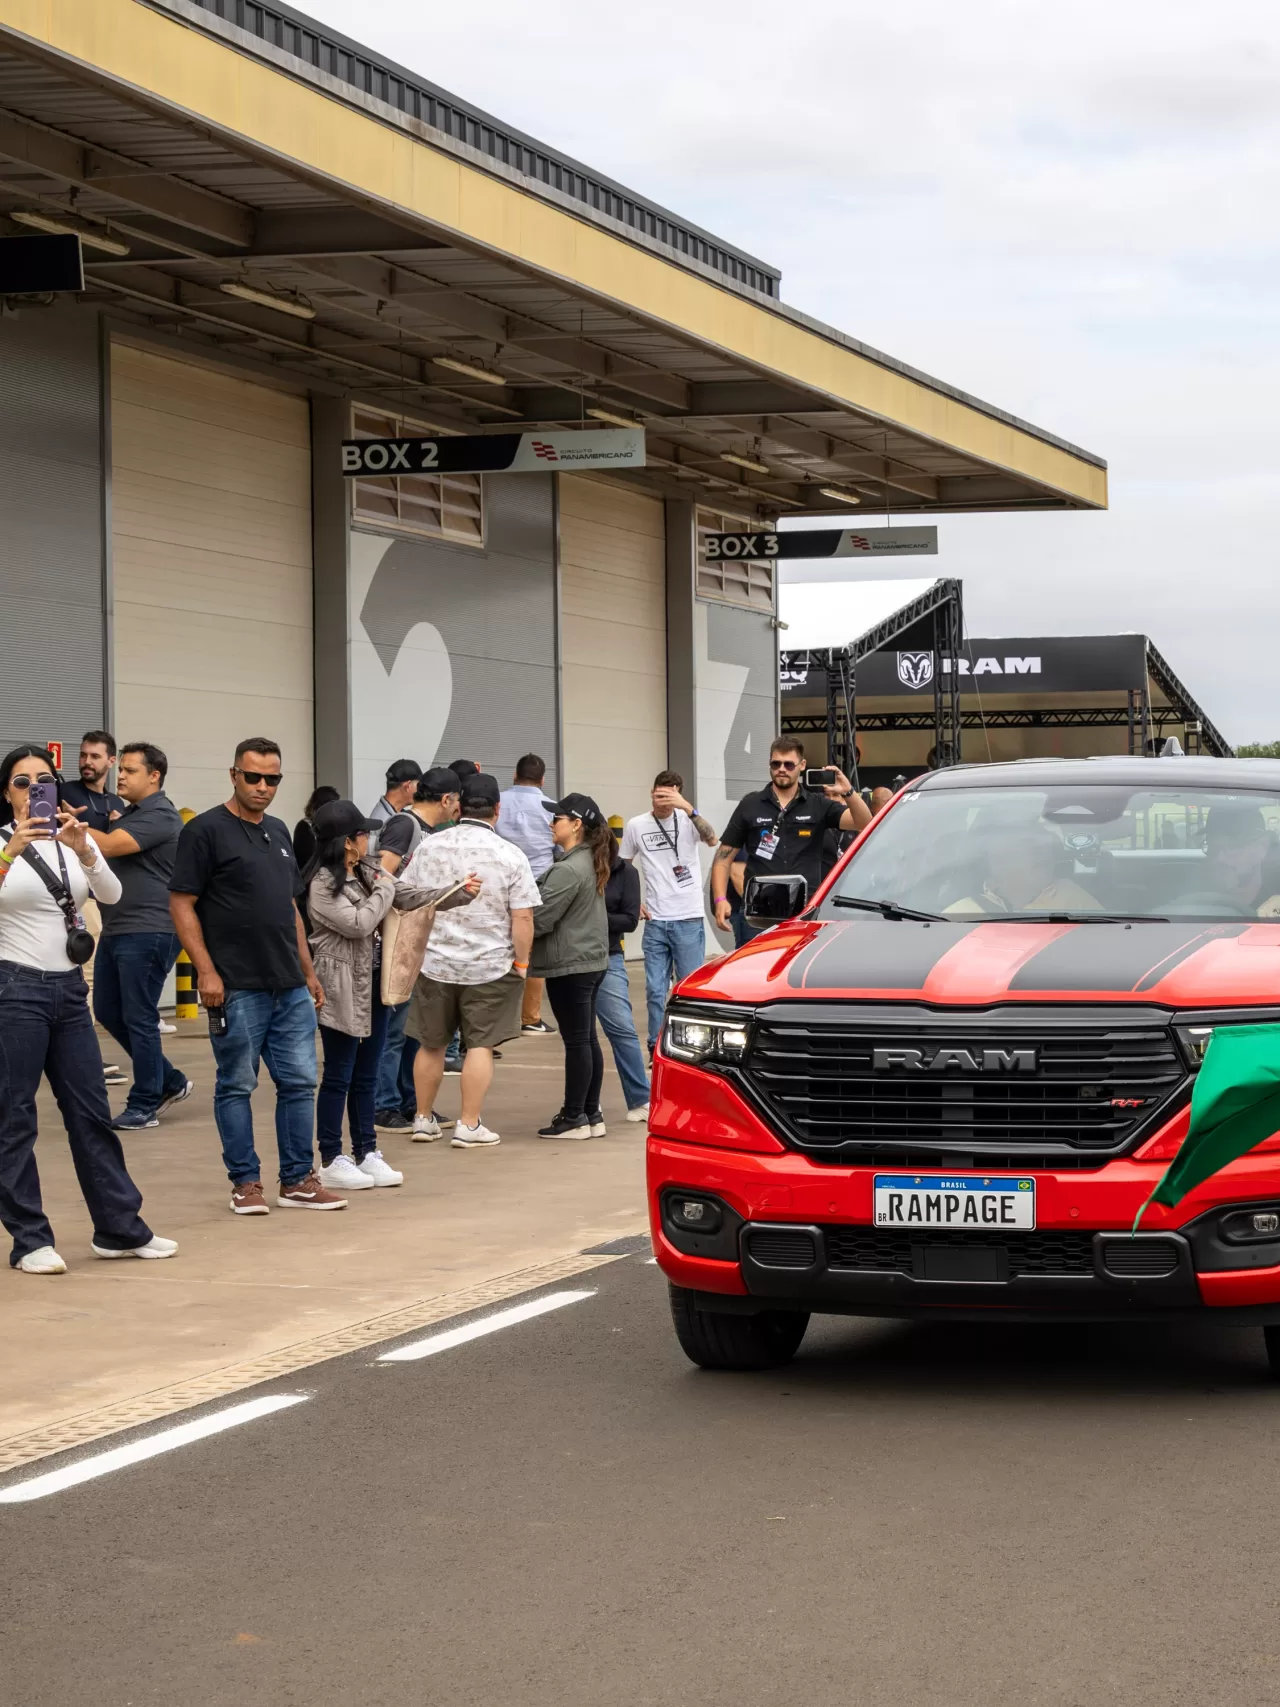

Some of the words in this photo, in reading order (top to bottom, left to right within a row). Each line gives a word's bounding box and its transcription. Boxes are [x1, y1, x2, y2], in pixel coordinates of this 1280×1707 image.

[342, 443, 412, 471] BOX
[421, 441, 439, 468] 2
[560, 452, 633, 461] PANAMERICANO
[705, 535, 758, 557] BOX
[764, 535, 779, 555] 3
[943, 657, 1041, 675] RAM
[873, 1048, 1036, 1071] RAM
[940, 1181, 967, 1189] BRASIL
[878, 1213, 887, 1222] BR
[889, 1193, 1016, 1224] RAMPAGE
